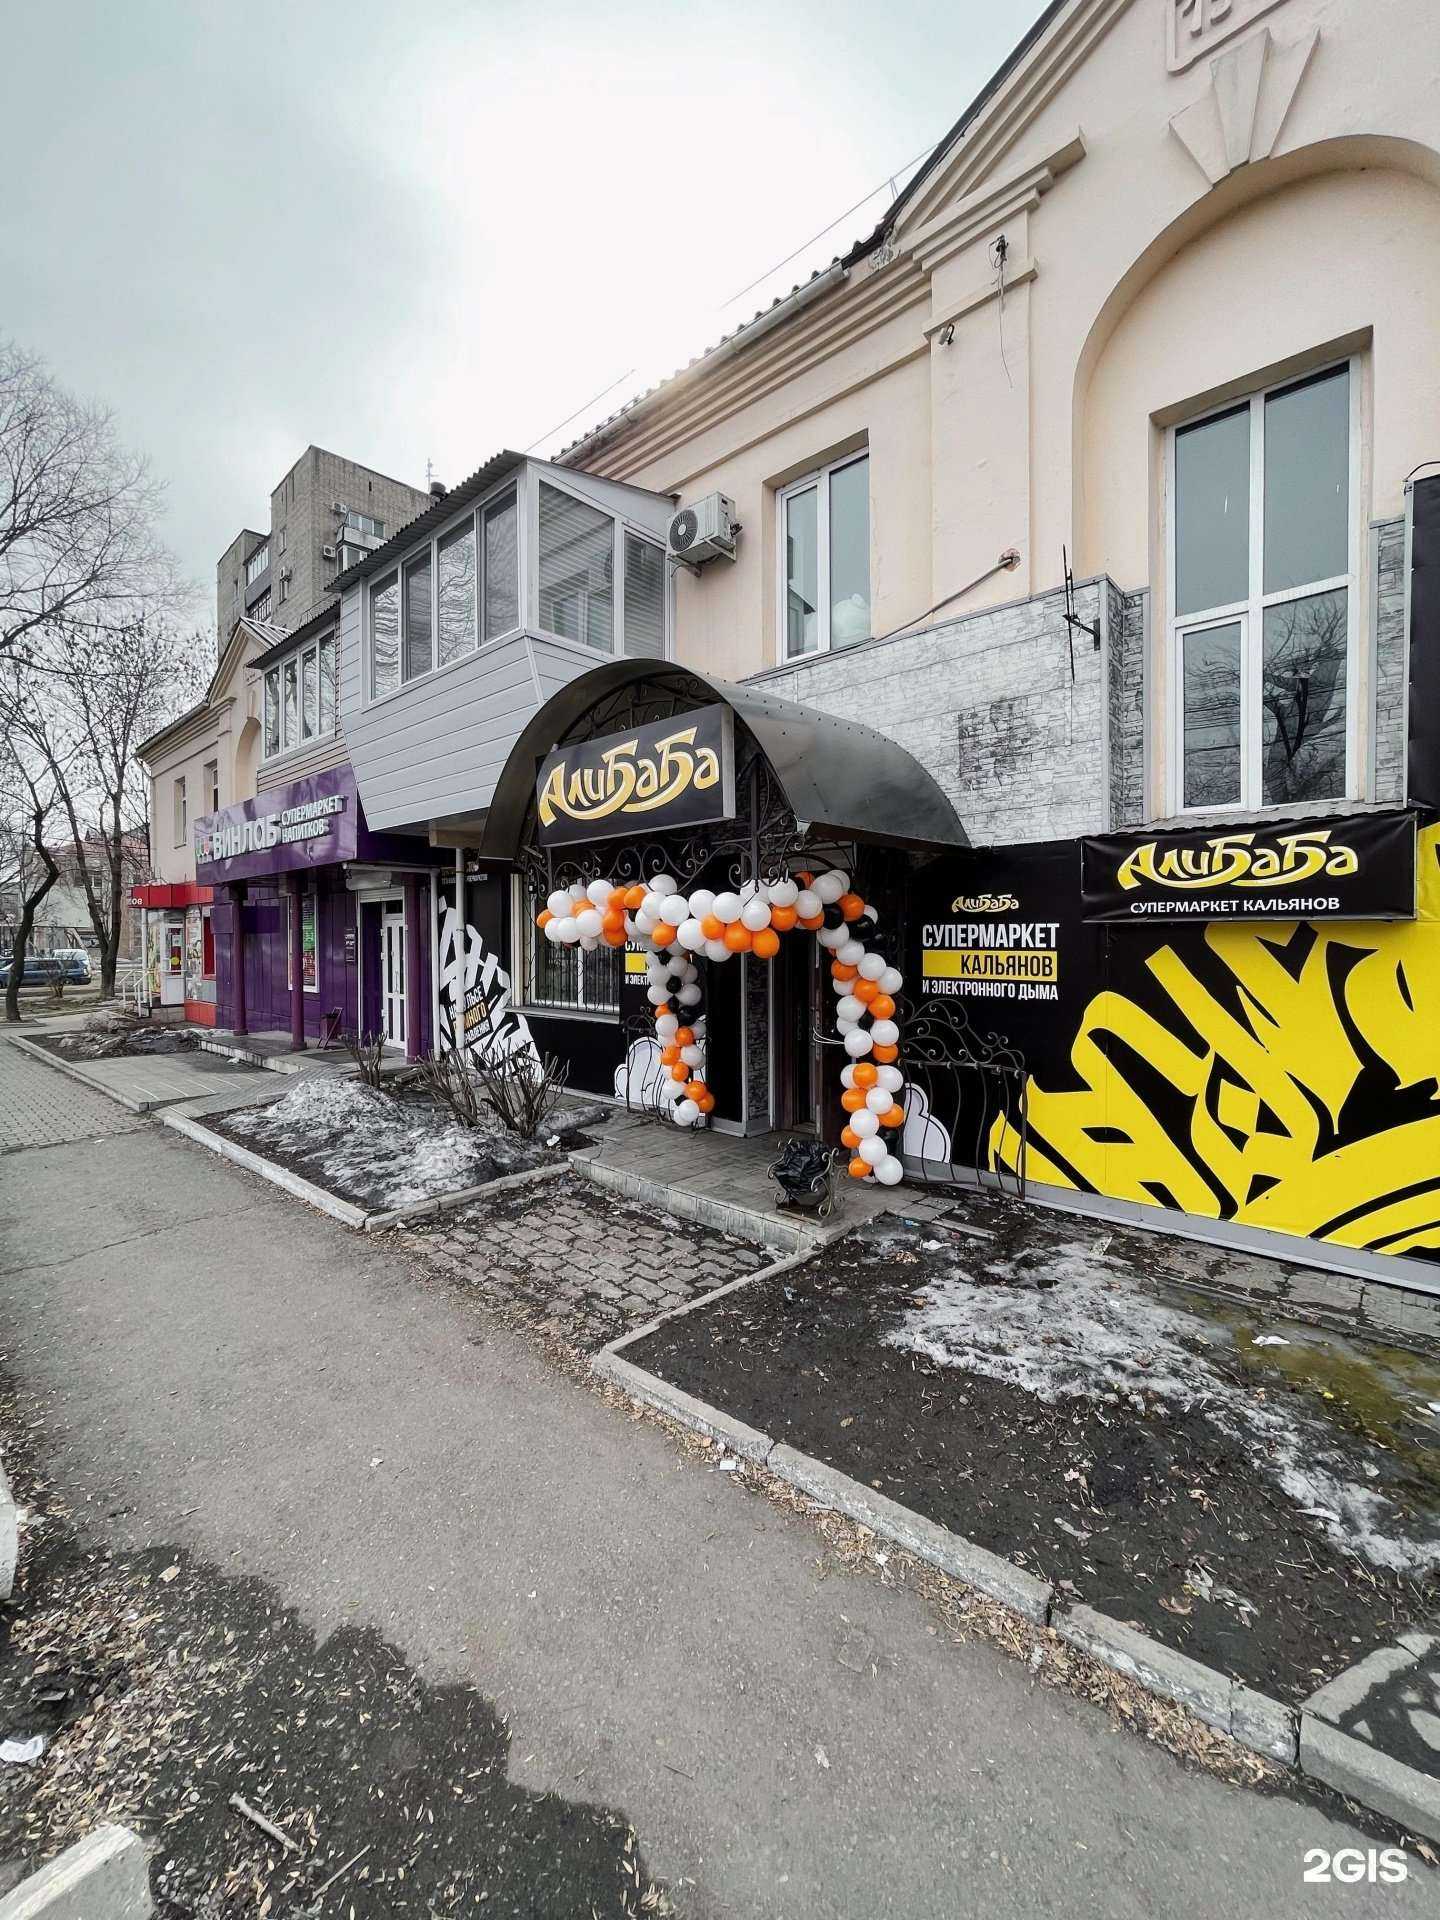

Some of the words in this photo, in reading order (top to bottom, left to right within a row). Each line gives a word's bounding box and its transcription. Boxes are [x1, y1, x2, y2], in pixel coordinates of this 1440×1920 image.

[282, 795, 345, 826] СУПЕРМАРКЕТ
[282, 818, 328, 844] НАПИТКОВ
[1130, 899, 1239, 914] СУПЕРМАРКЕТ
[1243, 897, 1340, 912] КАЛЬЯНОВ
[922, 923, 1060, 948] СУПЕРМАРКЕТ
[960, 954, 1053, 977] КАЛЬЯНОВ
[922, 980, 930, 994] И
[931, 980, 1016, 998] ЭЛЕКТРОННОГО
[1018, 983, 1059, 1001] ДЫМА
